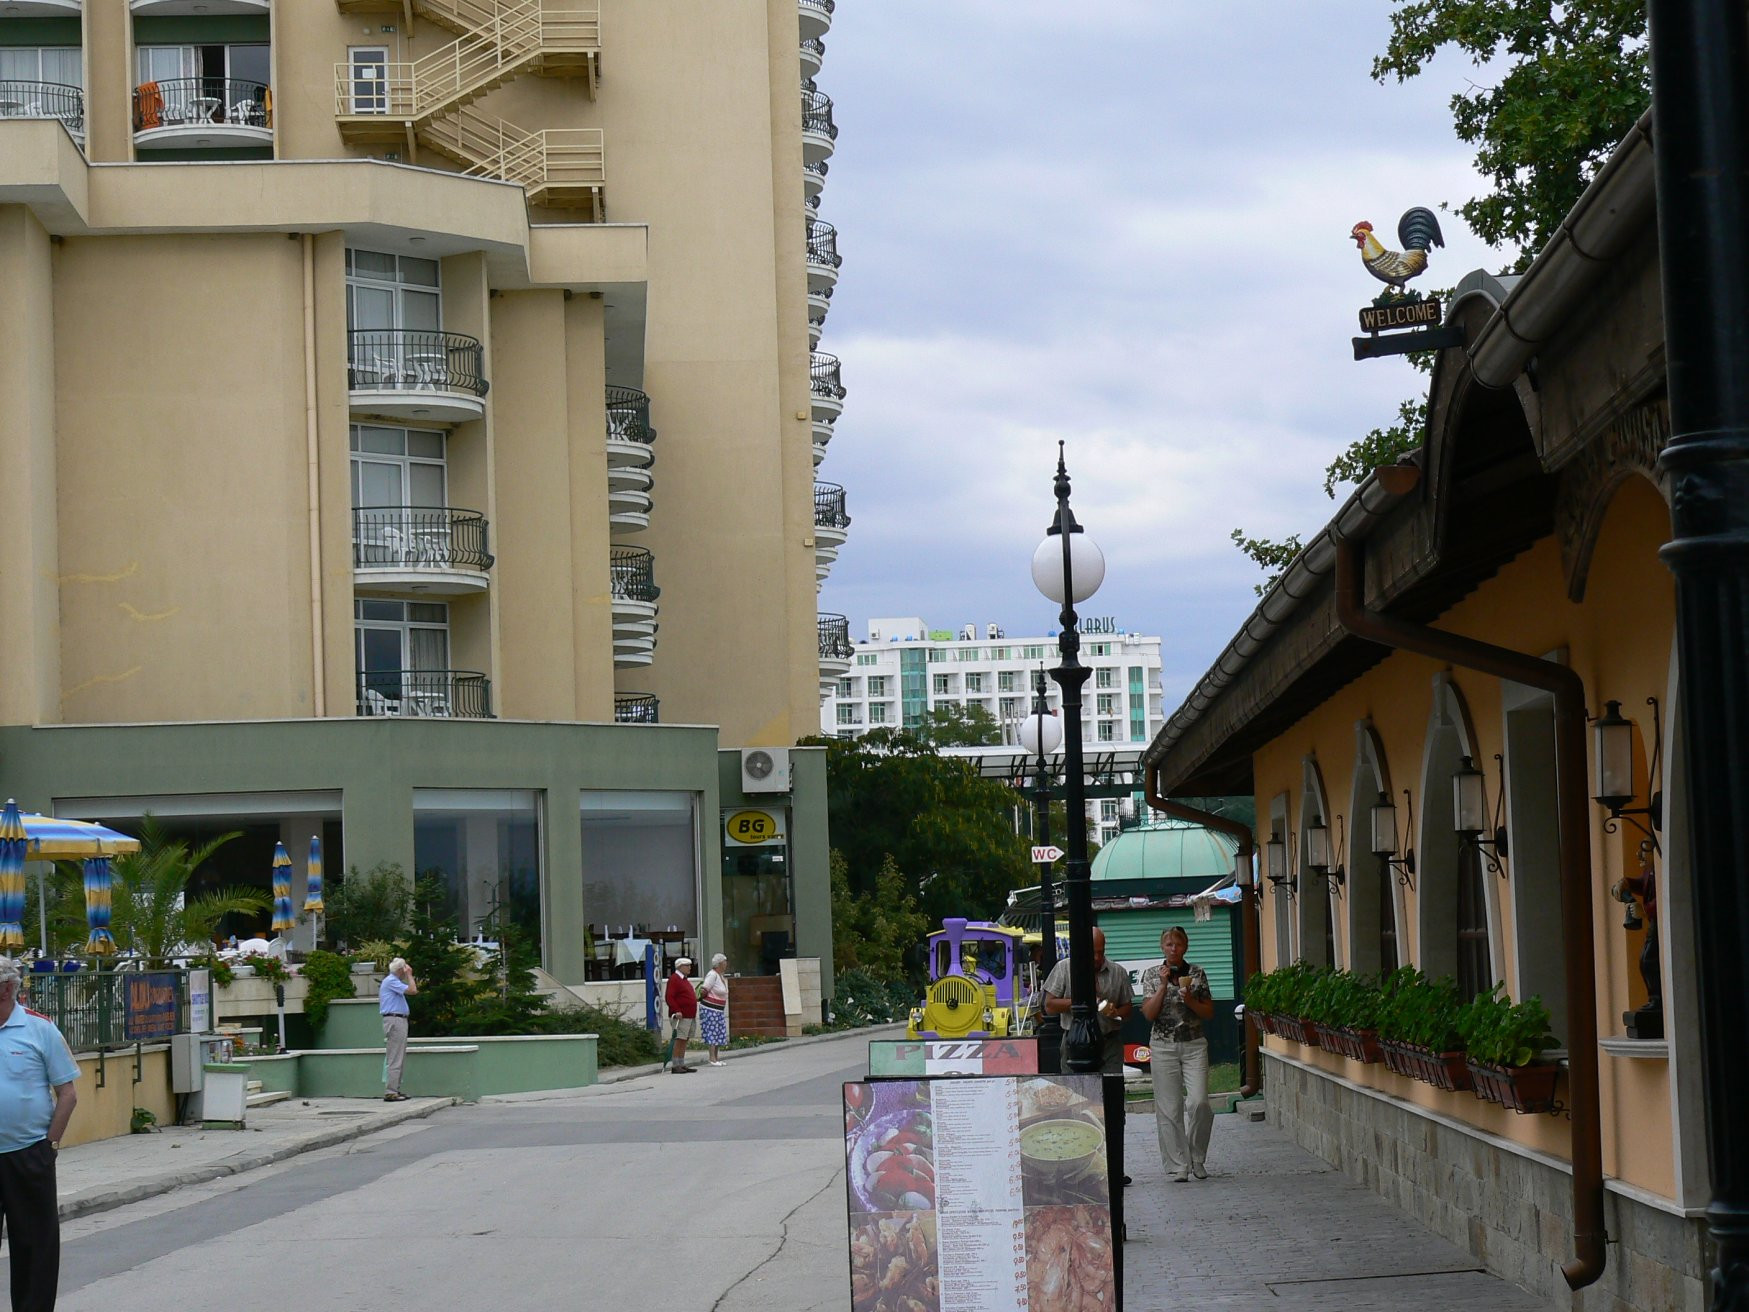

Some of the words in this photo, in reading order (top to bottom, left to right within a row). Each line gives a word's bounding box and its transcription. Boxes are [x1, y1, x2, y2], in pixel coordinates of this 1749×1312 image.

[1362, 303, 1437, 328] WELCOME
[1075, 616, 1115, 634] LARUS
[739, 819, 765, 834] BG
[1032, 848, 1057, 861] WC
[896, 1042, 1020, 1061] PIZZA
